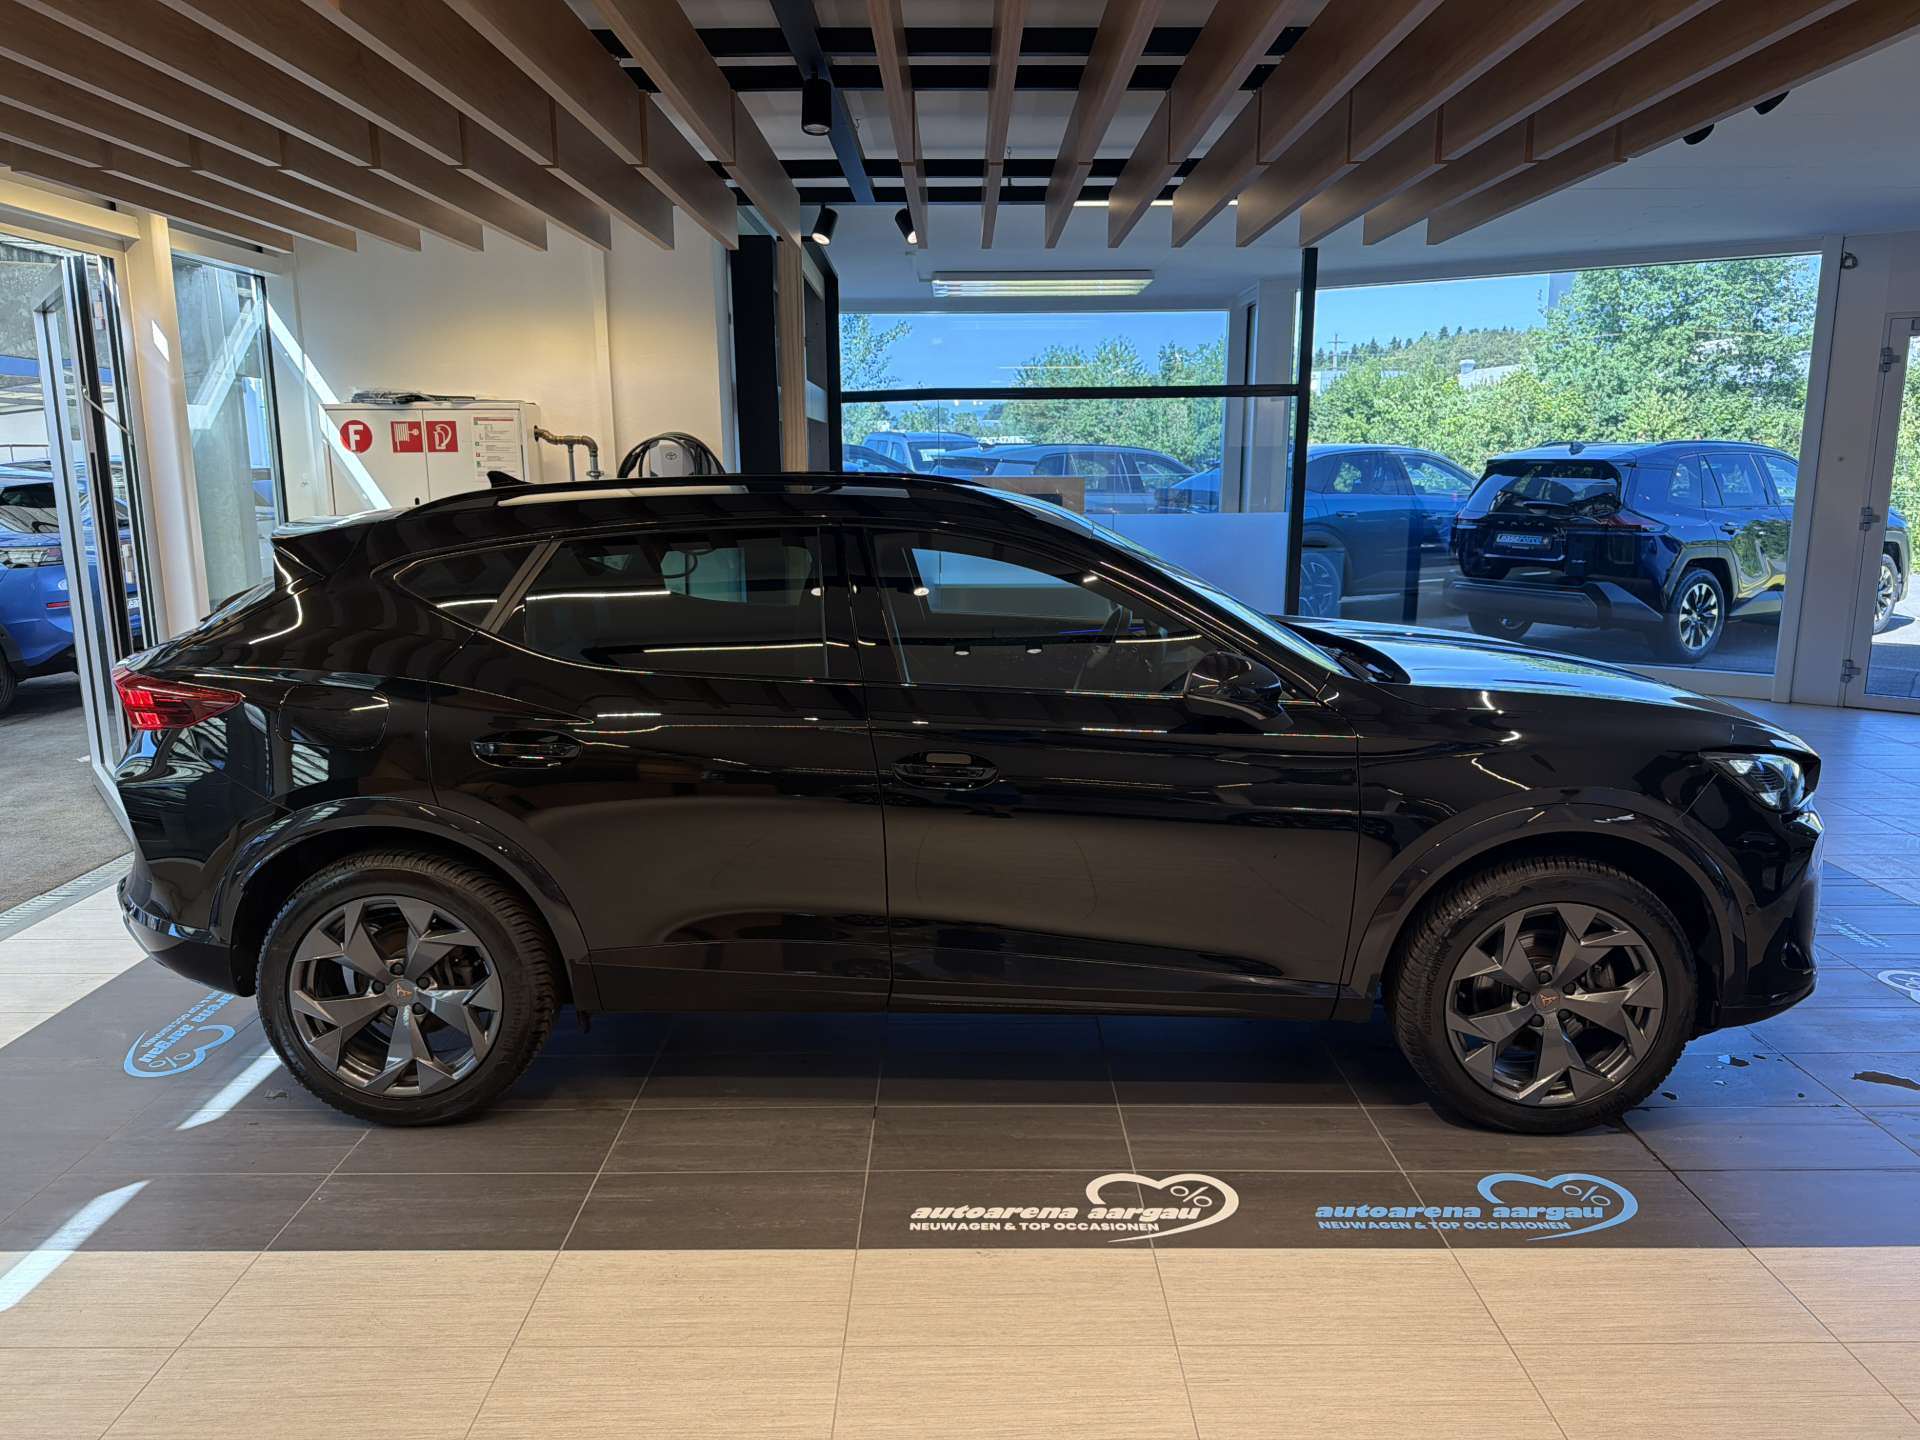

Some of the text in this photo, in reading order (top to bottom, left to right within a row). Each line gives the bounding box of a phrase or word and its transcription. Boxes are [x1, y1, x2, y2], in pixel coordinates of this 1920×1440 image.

[348, 424, 363, 451] F
[910, 1204, 1202, 1223] autoarena aargau
[1315, 1203, 1604, 1221] autoarena aargau
[909, 1222, 1160, 1232] NEUWAGEN & TOP OCCASIONEN
[1318, 1221, 1572, 1231] NEUWAGEN & TOP OCCASIONEN
